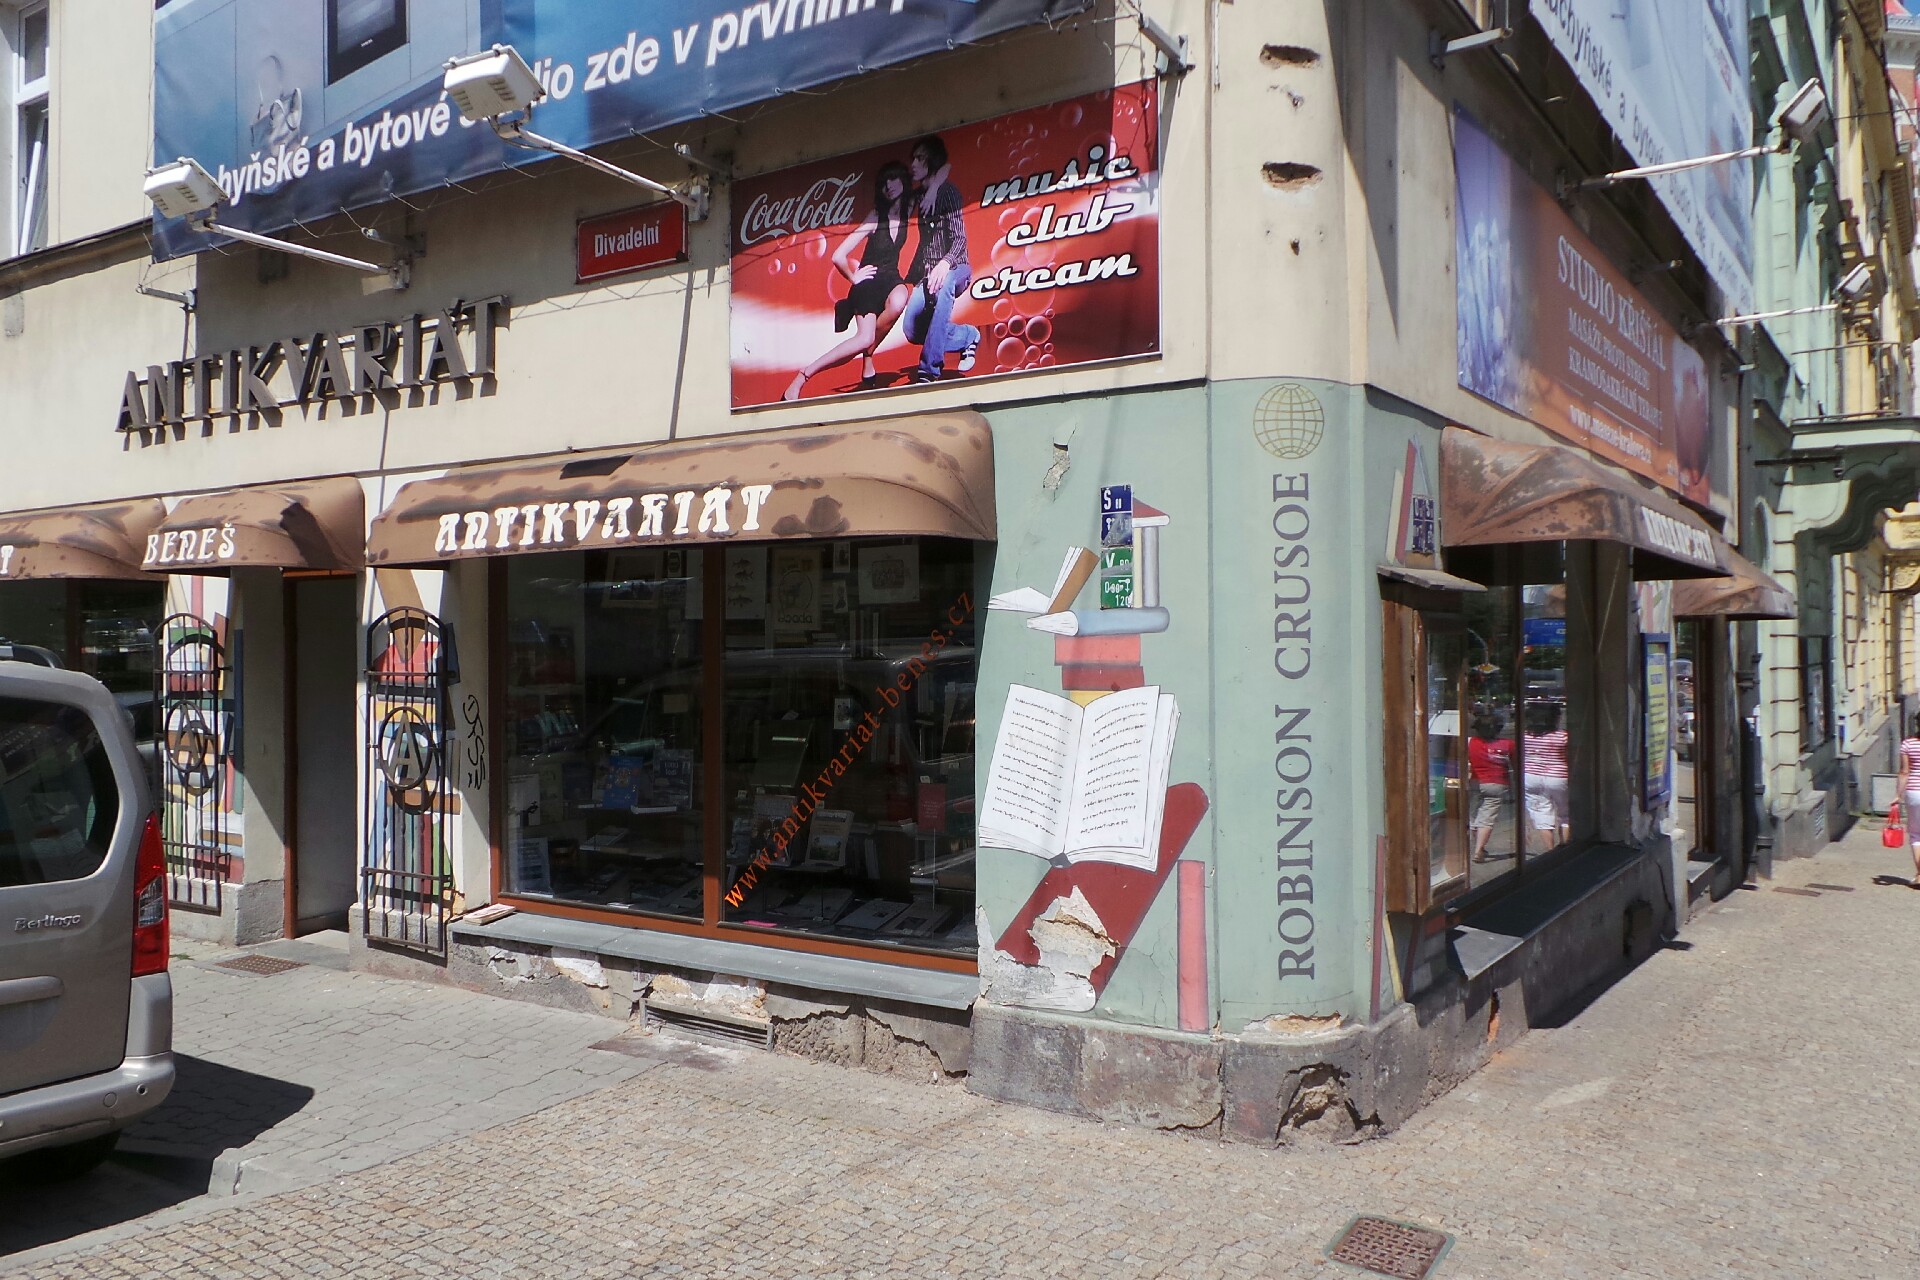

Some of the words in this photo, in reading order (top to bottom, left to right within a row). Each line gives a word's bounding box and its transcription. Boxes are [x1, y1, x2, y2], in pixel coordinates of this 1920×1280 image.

[214, 135, 310, 207] hyňské
[316, 138, 336, 172] a
[342, 91, 451, 169] bytové
[583, 32, 660, 92] zde
[672, 25, 699, 65] v
[1618, 92, 1627, 122] a
[981, 145, 1138, 207] music
[594, 219, 661, 258] Divadelní
[1006, 193, 1132, 247] club
[970, 252, 1138, 300] cream
[1557, 235, 1616, 325] STUDIO
[116, 295, 508, 433] ANTIKVARIÁT
[142, 522, 236, 565] BENEŠ
[434, 482, 773, 552] ANTIKVARIÁT
[1272, 472, 1312, 680] CRUSOE
[723, 591, 976, 910] www.antikvariat-benes.cz
[1274, 704, 1315, 981] ROBINSON
[14, 914, 82, 932] Berlingo
